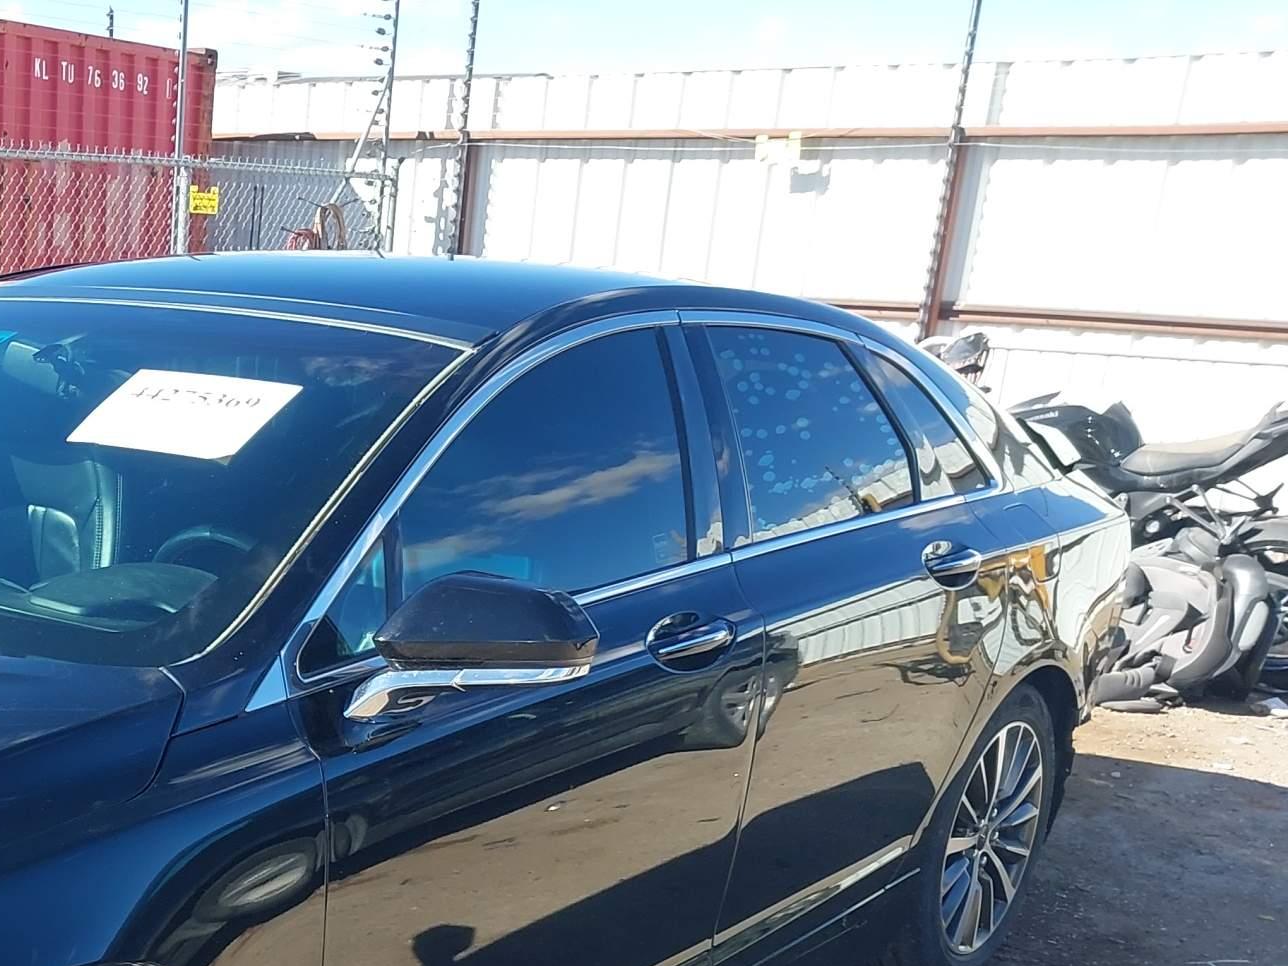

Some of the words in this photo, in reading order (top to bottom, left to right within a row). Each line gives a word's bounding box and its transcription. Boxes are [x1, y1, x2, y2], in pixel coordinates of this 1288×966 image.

[34, 58, 49, 80] KL
[61, 61, 75, 83] TU
[87, 66, 102, 88] 76
[112, 70, 125, 91] 36
[136, 73, 149, 95] 92
